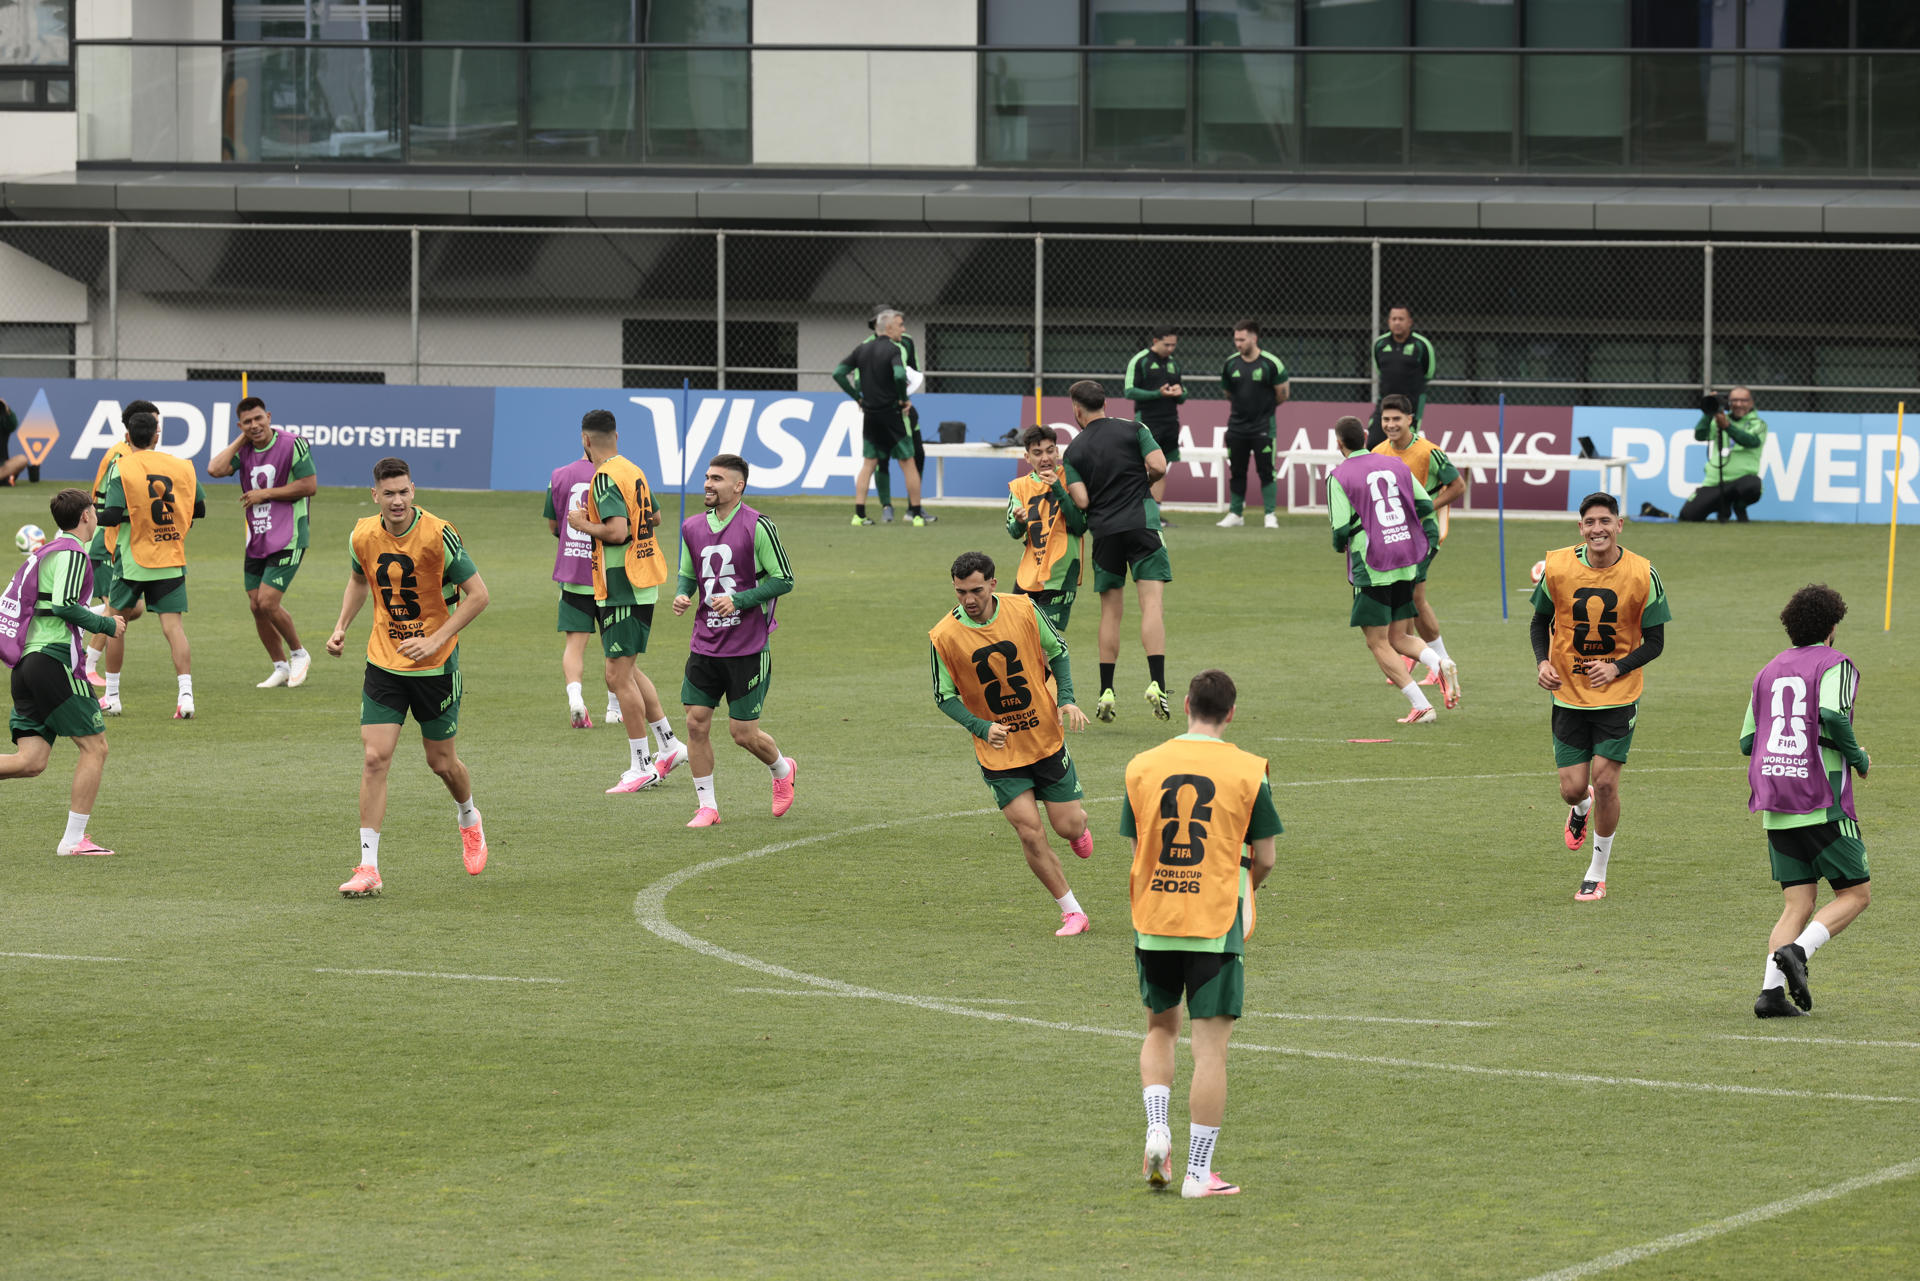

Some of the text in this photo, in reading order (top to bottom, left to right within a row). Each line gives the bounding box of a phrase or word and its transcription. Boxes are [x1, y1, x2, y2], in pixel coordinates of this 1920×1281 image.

[270, 423, 462, 448] EDICTSTREET
[629, 396, 878, 490] VISA
[565, 541, 585, 549] WORLD
[1, 600, 17, 611] FIFA
[390, 607, 410, 616] FIFA
[408, 621, 424, 630] CUP
[706, 616, 742, 628] 2026
[1583, 643, 1604, 651] FIFA
[1001, 697, 1022, 708] FIFA
[1022, 709, 1036, 720] CUP
[1006, 717, 1040, 735] 026
[1777, 738, 1798, 749] FIFA
[1762, 755, 1808, 766] WORLD CUP
[1761, 764, 1809, 779] 2026
[1169, 847, 1192, 859] FIFA
[1154, 868, 1202, 880] WORLD CUP
[1150, 878, 1201, 894] 2026
